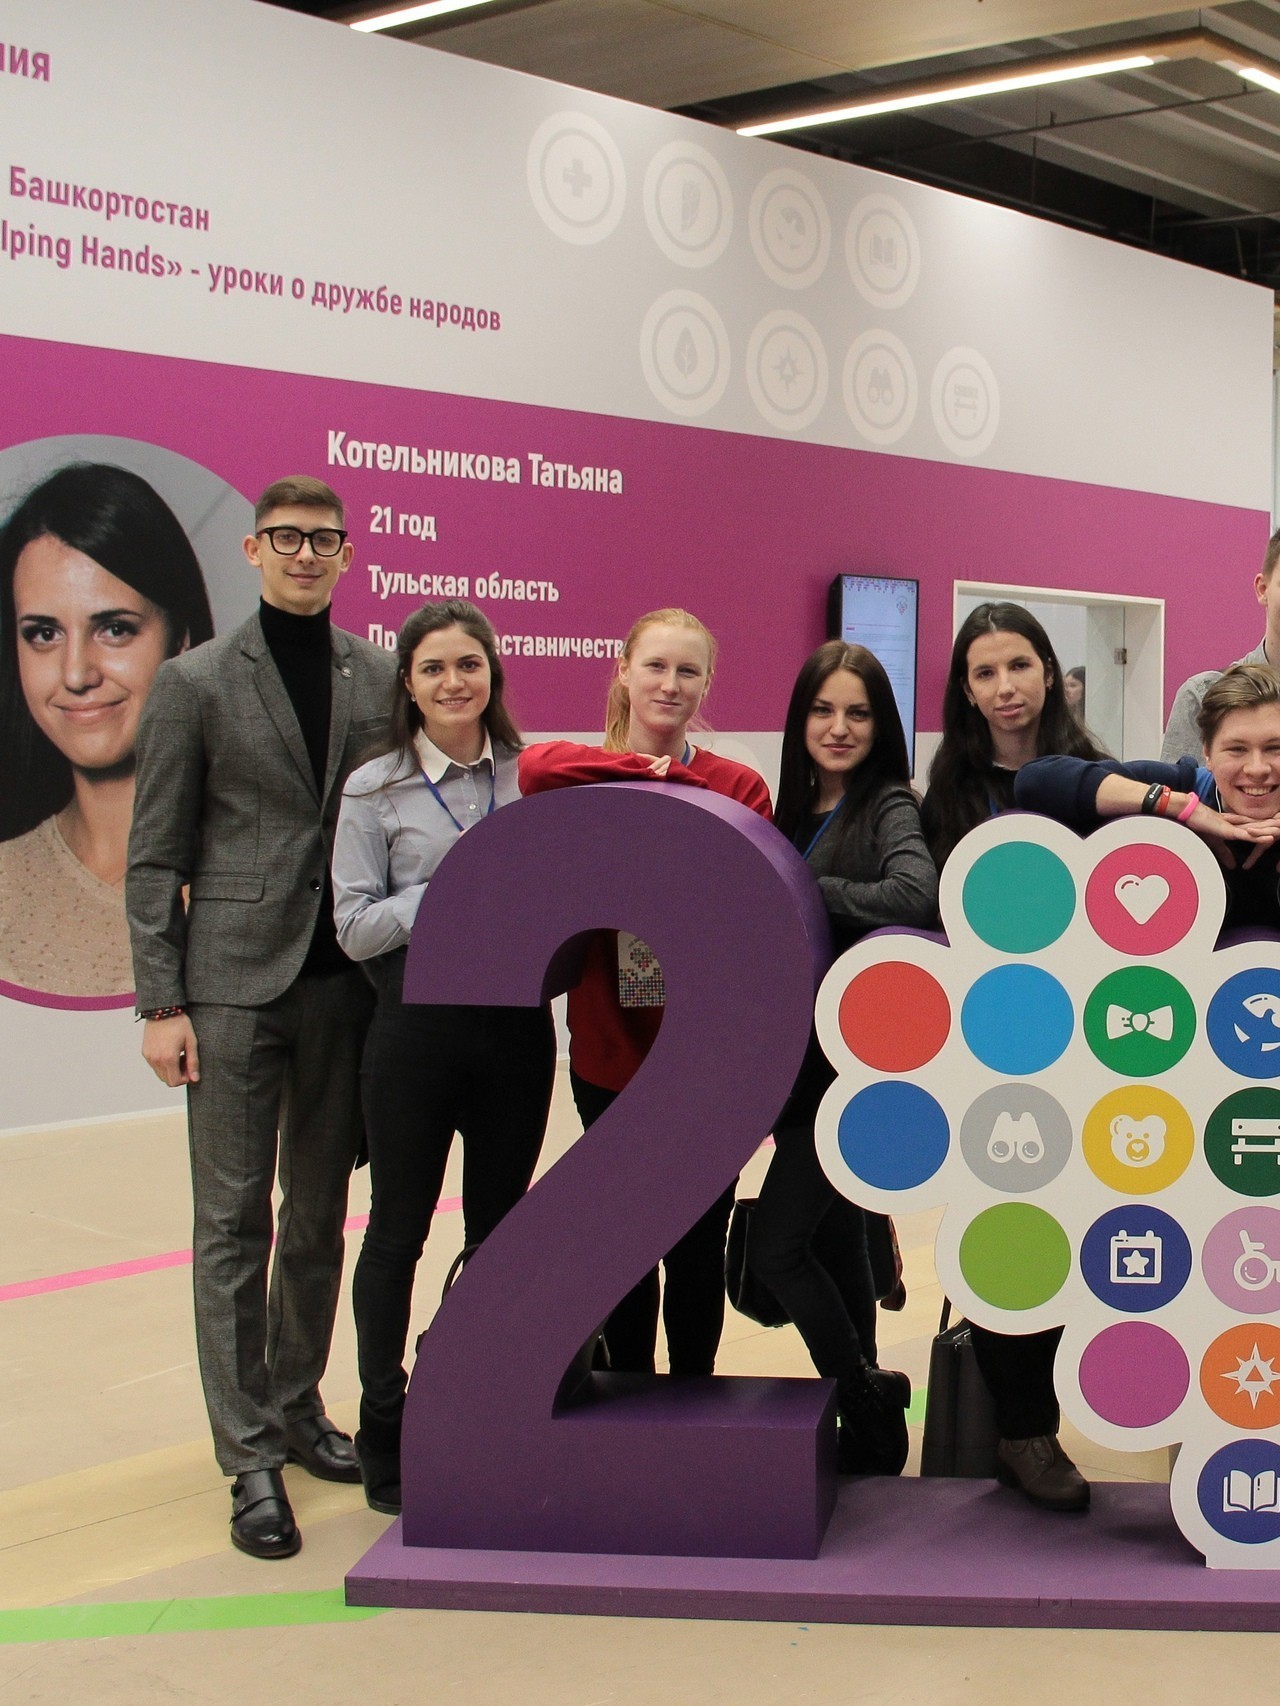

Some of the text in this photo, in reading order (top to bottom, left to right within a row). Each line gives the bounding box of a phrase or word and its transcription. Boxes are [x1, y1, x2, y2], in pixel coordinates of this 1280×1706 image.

[10, 165, 209, 232] Башкортостан
[2, 220, 71, 269] lping
[82, 235, 183, 277] Hands»
[208, 263, 283, 295] уроки
[291, 277, 305, 300] о
[311, 281, 402, 314] дружбе
[409, 297, 500, 331] народов
[327, 430, 623, 494] Котельникова Татьяна
[370, 505, 437, 542] 21 год
[368, 565, 560, 602] Тульская область
